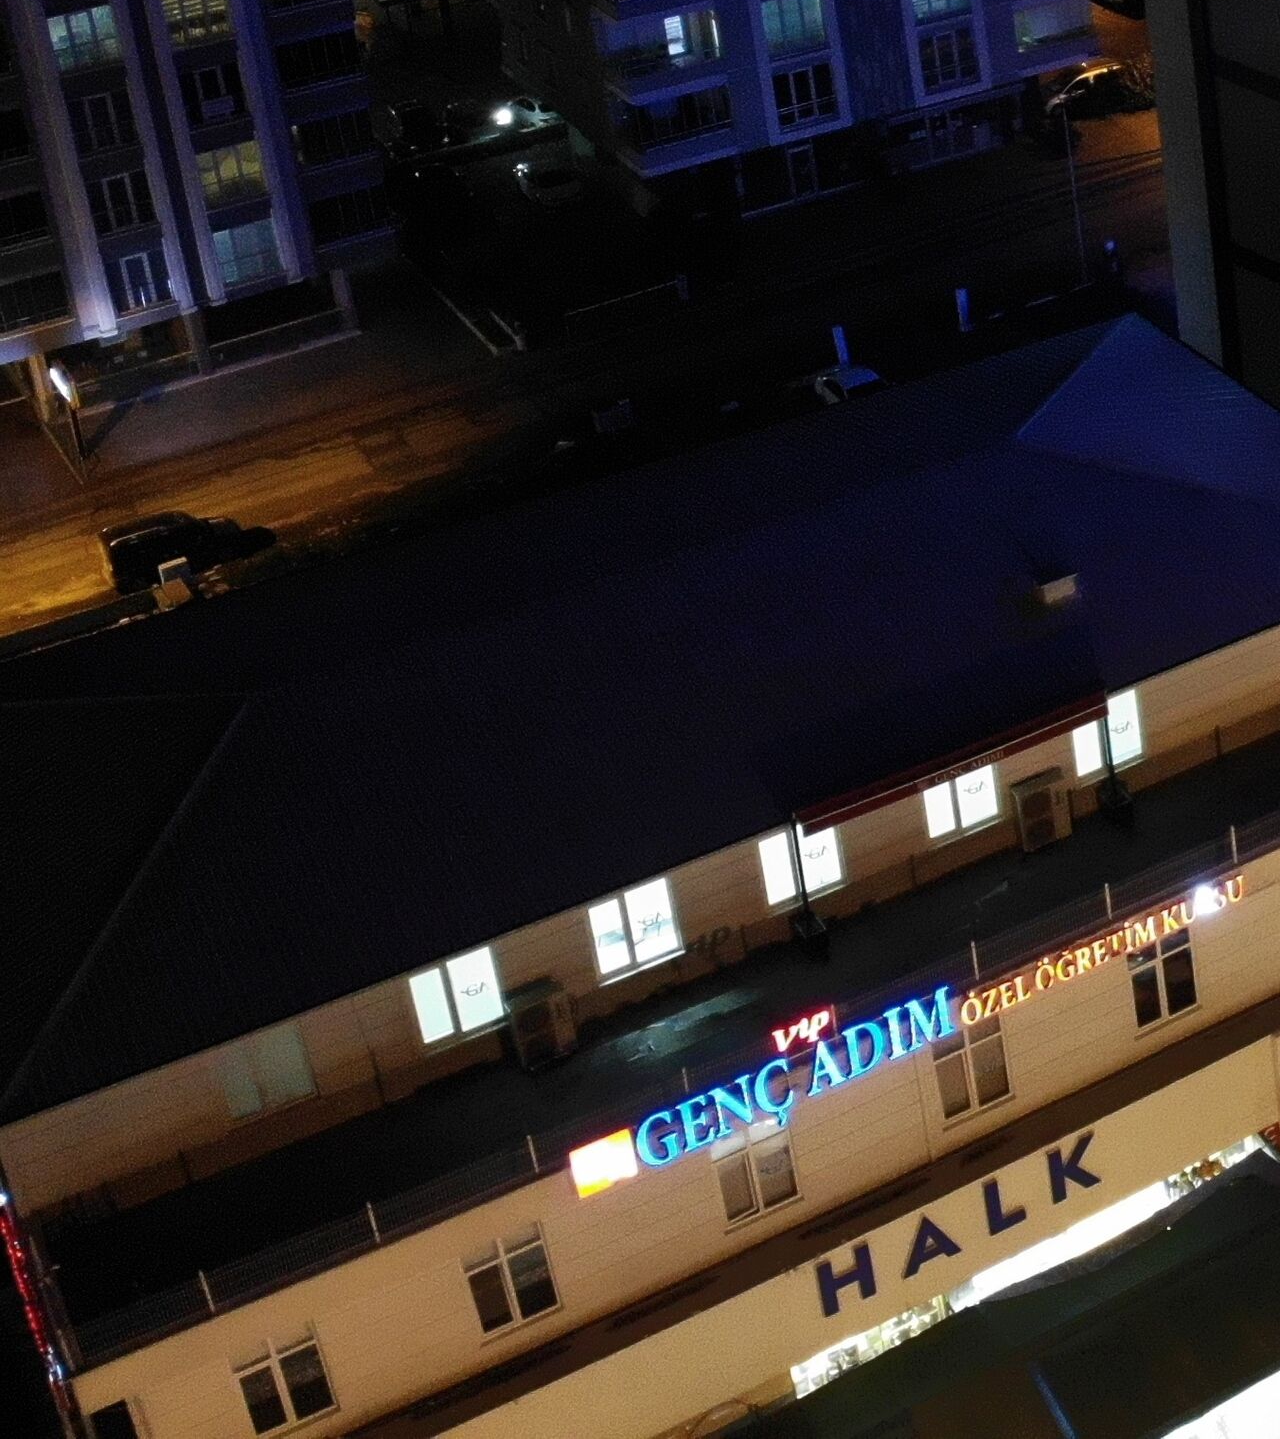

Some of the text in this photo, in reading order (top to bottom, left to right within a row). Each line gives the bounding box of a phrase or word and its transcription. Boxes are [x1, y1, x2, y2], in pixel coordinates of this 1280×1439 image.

[636, 875, 1243, 1167] GENÇ ADIM ÖZEL ÖĞRETİM KUSU
[816, 1130, 1102, 1318] HALK
